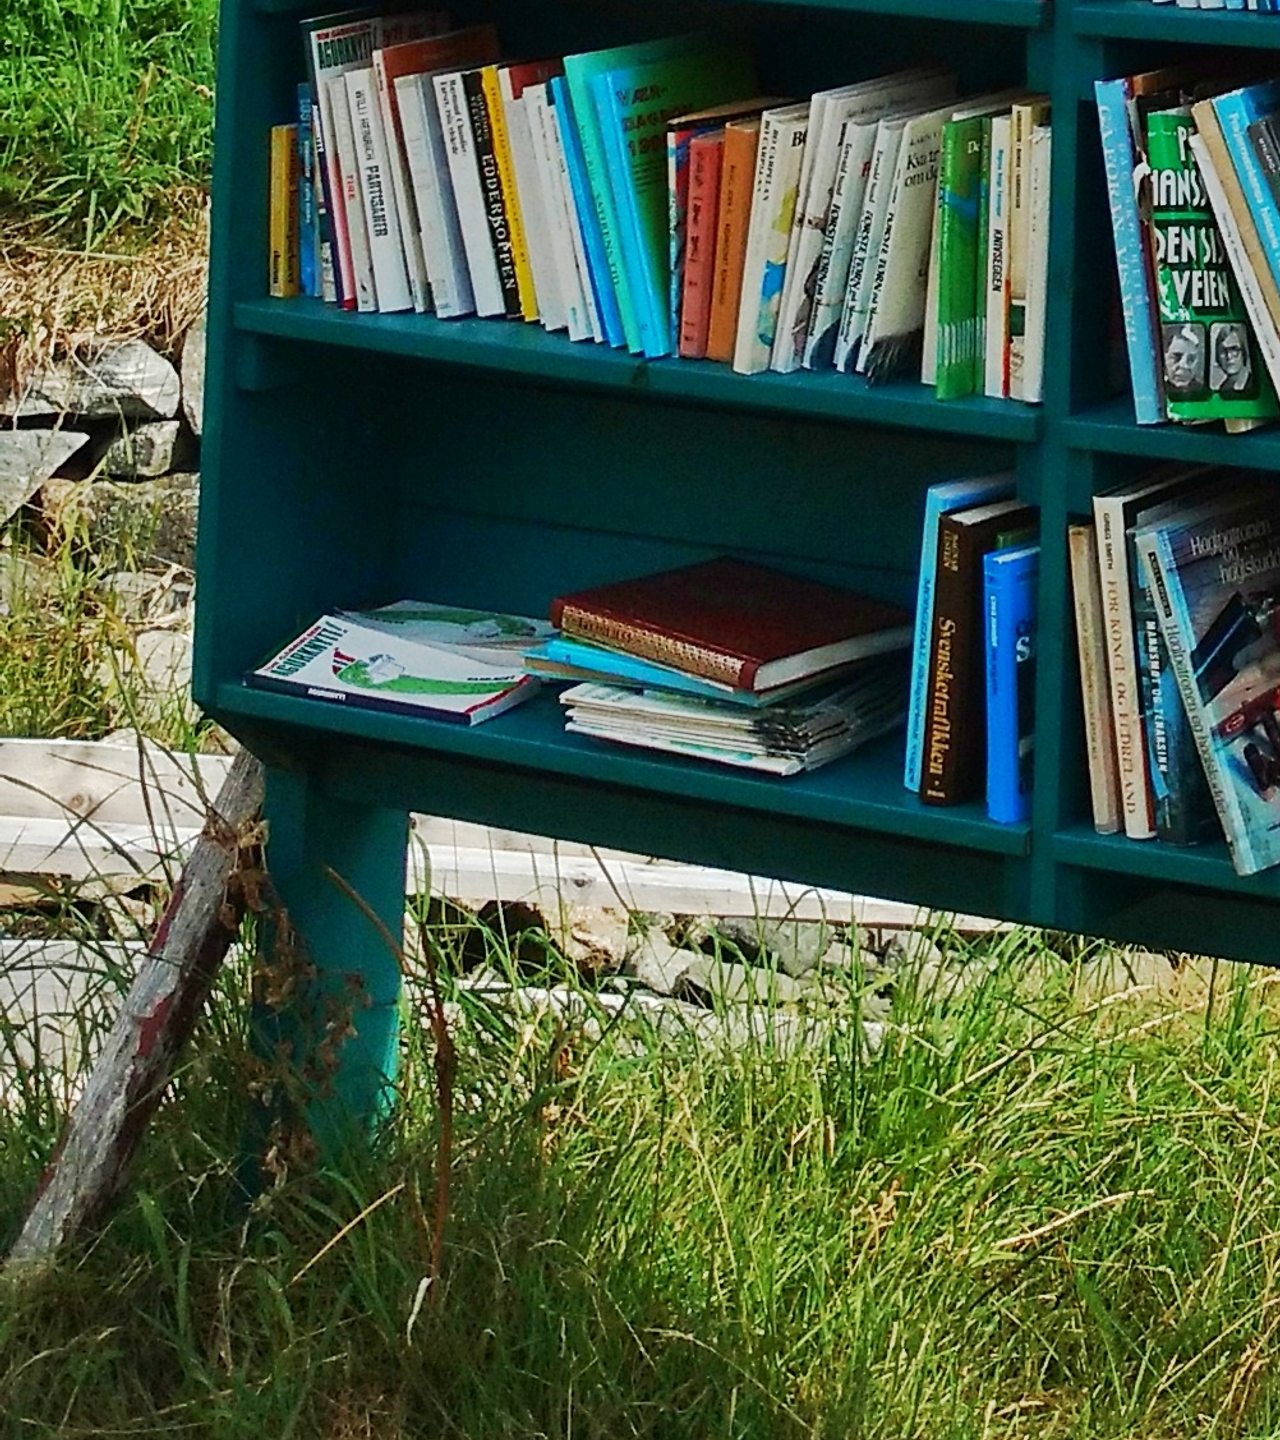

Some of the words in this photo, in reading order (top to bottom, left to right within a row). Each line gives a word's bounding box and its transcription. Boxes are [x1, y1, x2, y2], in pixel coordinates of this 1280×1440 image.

[446, 78, 463, 116] Raymond
[761, 145, 777, 201] CARPELAN
[477, 153, 516, 290] EDDERKOPPEN
[1172, 270, 1230, 308] VEIEN
[1189, 518, 1273, 558] Haglpatronen
[1105, 579, 1120, 615] FOR
[1144, 620, 1161, 684] MANNSMOT
[1160, 622, 1204, 712] Haglpatronen
[927, 616, 956, 774] Svensketrafikken
[1114, 681, 1129, 706] OG
[1112, 710, 1142, 814] FEDRELAND
